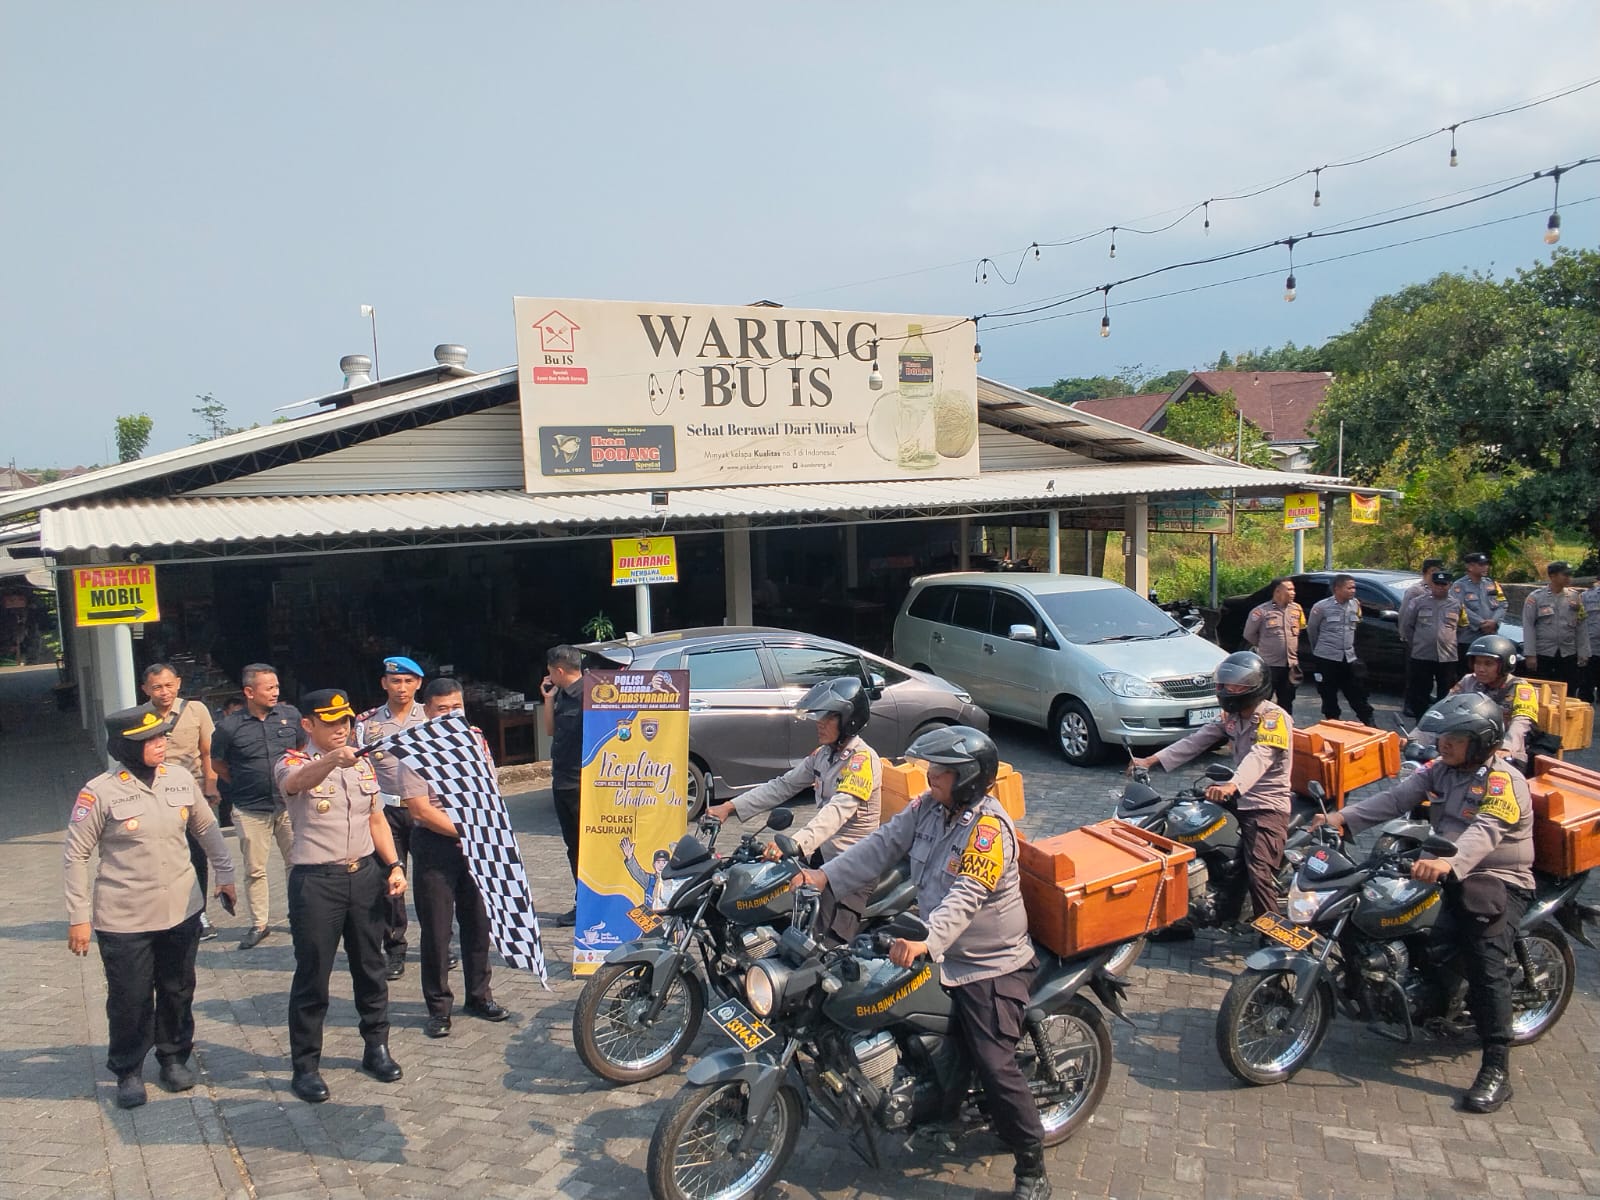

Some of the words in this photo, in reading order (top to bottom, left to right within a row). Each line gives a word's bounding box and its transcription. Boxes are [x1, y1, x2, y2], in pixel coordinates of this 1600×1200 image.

[637, 314, 880, 362] WARUNG
[544, 354, 560, 364] Bu
[562, 354, 574, 365] IS
[700, 365, 768, 408] BU
[787, 366, 834, 408] IS
[686, 423, 724, 436] Sehat
[728, 422, 779, 436] Berawal
[784, 422, 811, 435] Dari
[814, 422, 857, 438] Minyak
[591, 447, 660, 462] DORANG
[754, 450, 781, 458] Kualitas
[619, 554, 670, 569] DILARANG
[80, 568, 151, 588] PARKIR
[91, 588, 143, 607] MOBIL
[614, 675, 644, 685] POLISI
[618, 693, 680, 703] MASYARAKAT
[600, 752, 672, 794] Kopling
[600, 815, 633, 823] POLRES
[586, 825, 633, 834] PASURUAN
[856, 966, 932, 1016] BHABINKAMTIBMAS
[752, 1020, 762, 1030] X
